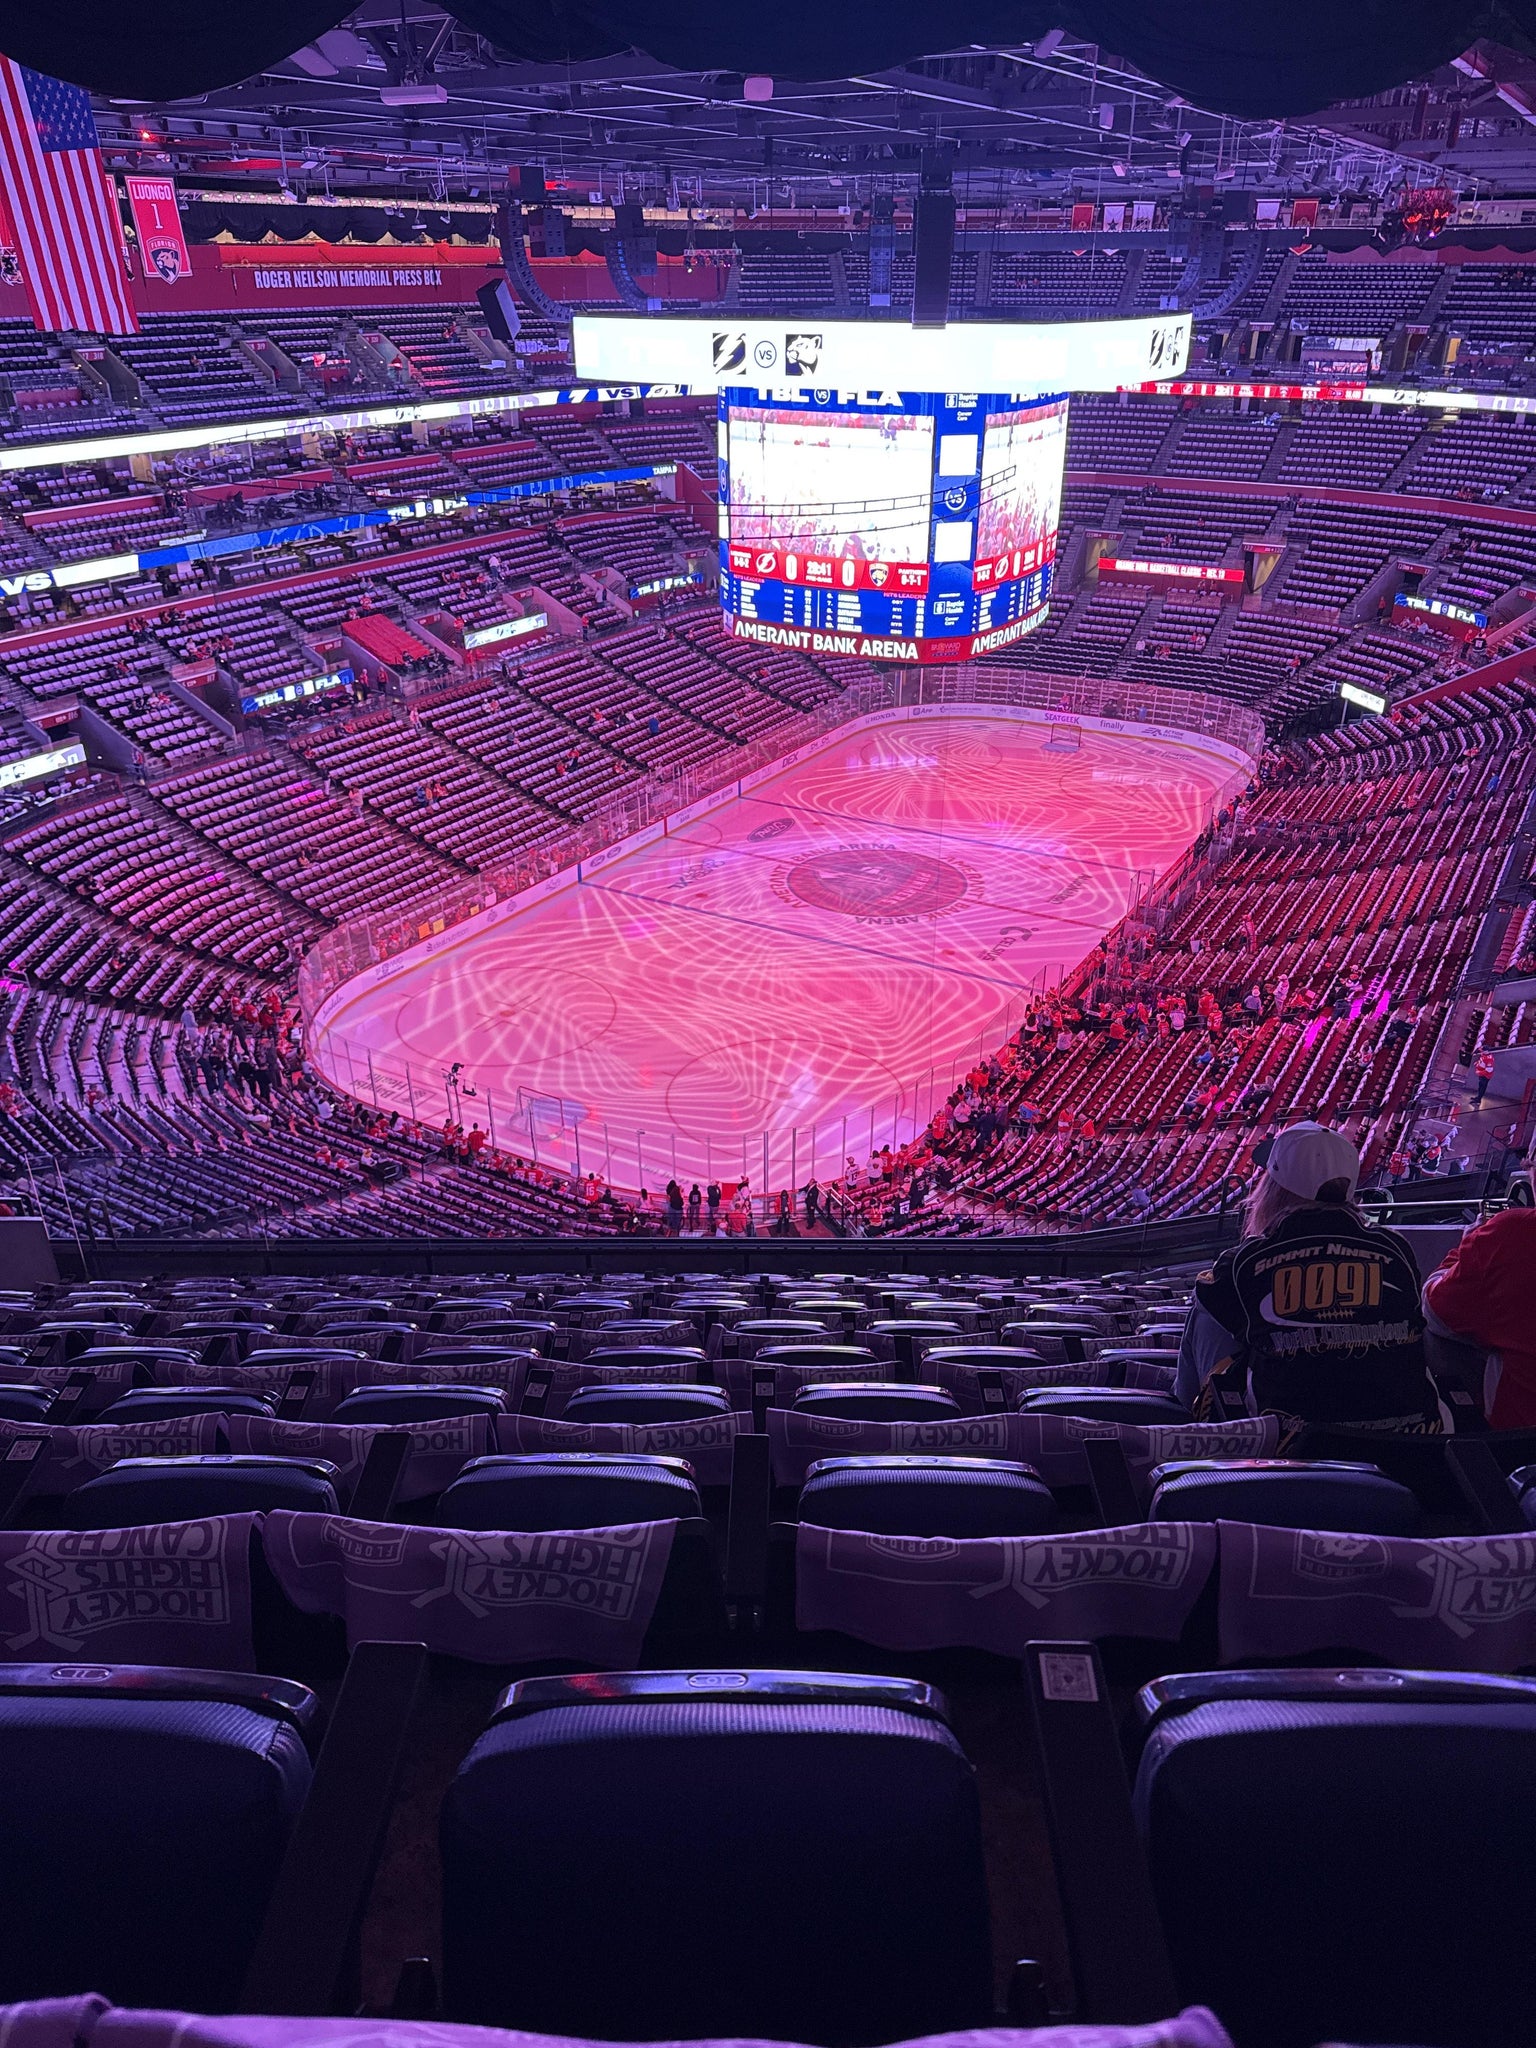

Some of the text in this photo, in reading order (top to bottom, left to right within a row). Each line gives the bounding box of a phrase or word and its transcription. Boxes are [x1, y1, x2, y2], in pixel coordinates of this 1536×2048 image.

[132, 184, 172, 200] LUONGO
[150, 203, 163, 229] 1
[254, 269, 442, 288] ROGER NEILSON MEMORIAL PRESS BOX
[758, 349, 773, 360] VS
[606, 387, 634, 398] VS
[758, 387, 811, 404] TBL
[837, 388, 903, 407] FLA
[445, 496, 469, 508] FLA
[786, 554, 798, 580] 0
[842, 560, 855, 587] 0
[1, 572, 52, 596] VS
[1406, 597, 1475, 623] TBL FLA
[734, 620, 919, 660] AMERANT BANK ARENA
[971, 625, 1022, 655] AMERANT
[315, 674, 341, 689] FLA
[870, 711, 897, 723] HONDA
[1044, 713, 1079, 725] SEATGEEK
[1100, 719, 1125, 732] finally
[782, 752, 800, 768] DEX
[756, 821, 788, 839] Ford
[839, 842, 897, 851] ARENA
[854, 915, 920, 926] ARENA
[982, 936, 1018, 962] CELSIUS
[1254, 1243, 1394, 1277] SUMMIT NINETY
[1273, 1261, 1382, 1316] 0091
[1269, 1326, 1318, 1351] World
[642, 1419, 732, 1450] HOCKEY
[910, 1421, 1001, 1448] HOCKEY
[1168, 1434, 1258, 1456] HOCKEY
[96, 1436, 194, 1459] HOCKEY
[500, 1535, 634, 1581] FIGHTS
[1033, 1544, 1178, 1583] HOCKEY
[74, 1559, 213, 1588] FIGHTS
[471, 1569, 625, 1613] HOCKEY
[62, 1589, 213, 1630] HOCKEY
